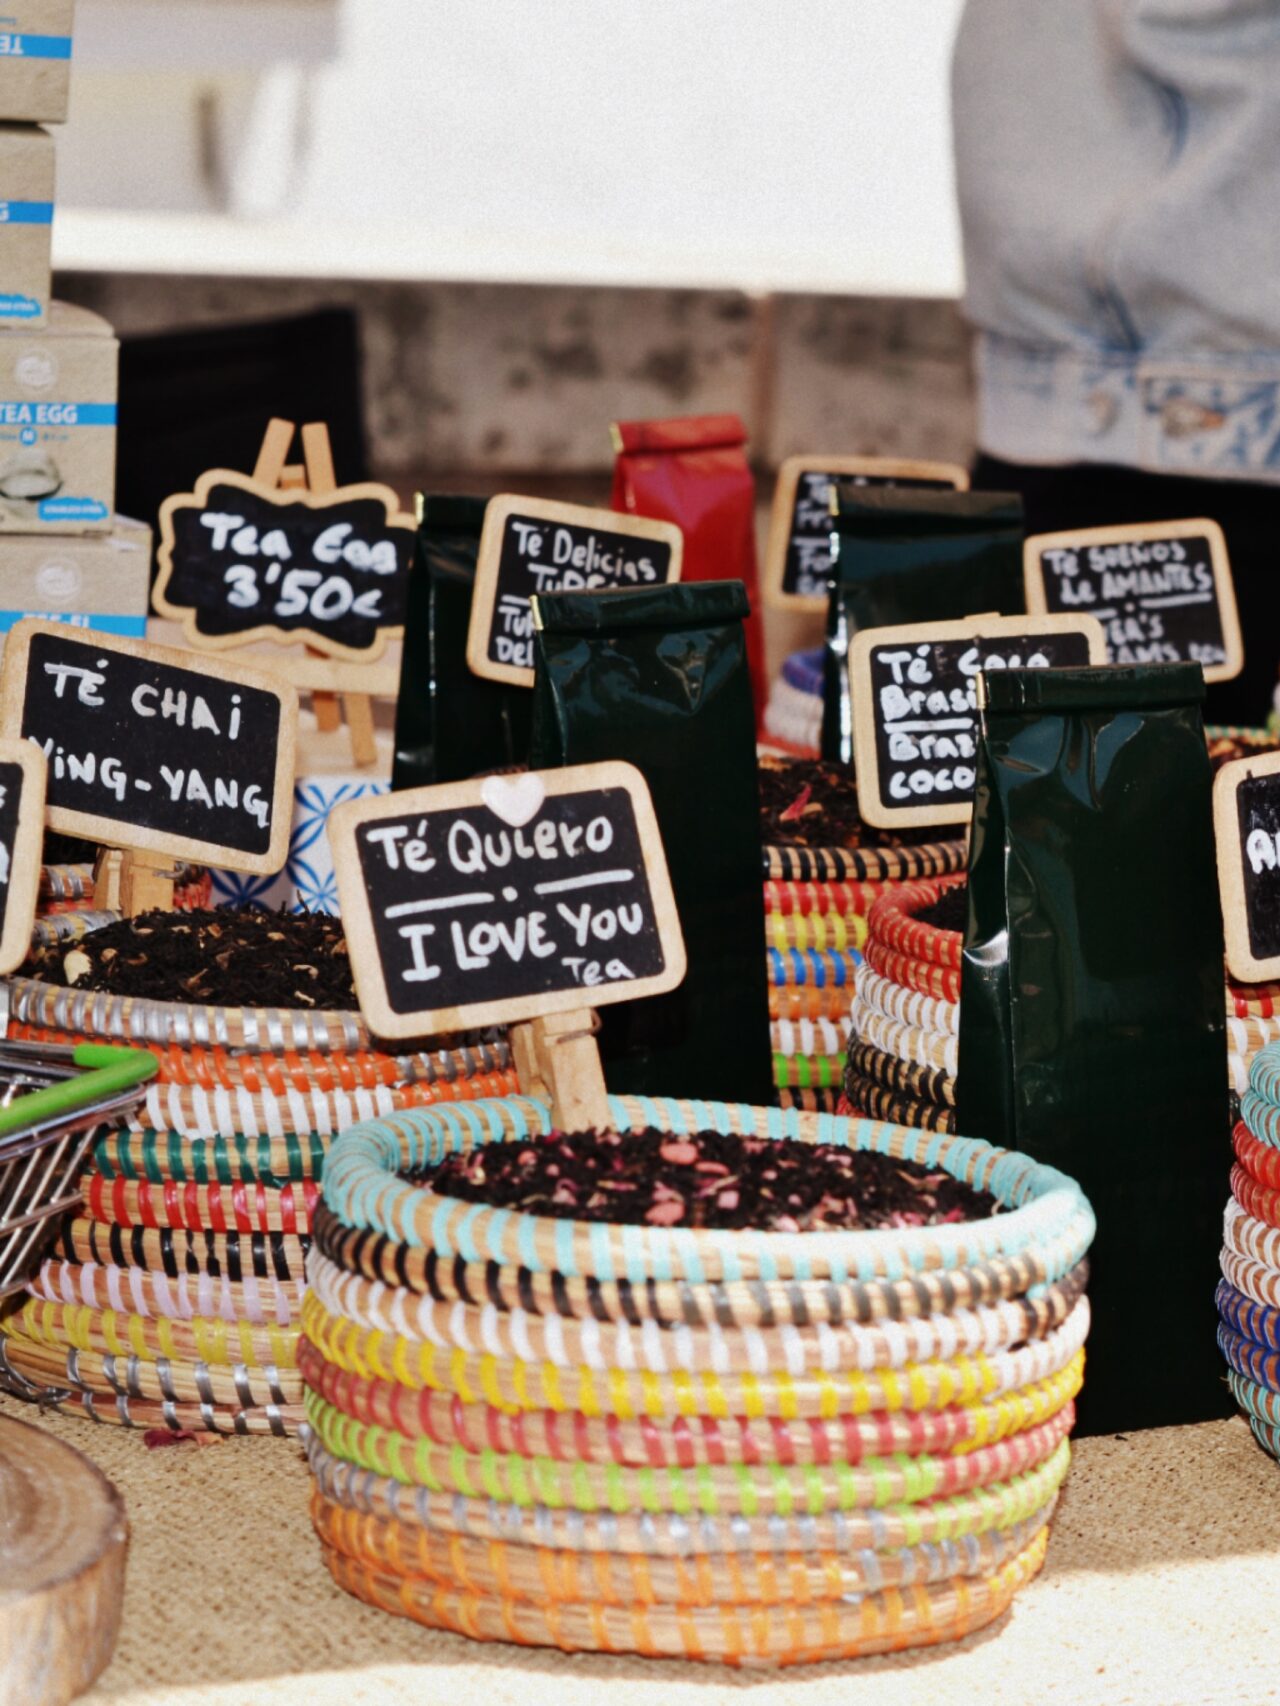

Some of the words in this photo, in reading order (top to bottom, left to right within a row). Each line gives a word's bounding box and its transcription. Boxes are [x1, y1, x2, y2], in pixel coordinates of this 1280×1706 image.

[36, 404, 77, 424] EGG
[200, 512, 292, 560] Tea
[553, 529, 656, 582] Delicias
[399, 924, 441, 981] I
[451, 912, 557, 970] LOVE
[557, 902, 643, 947] YOU
[561, 957, 635, 987] Tea
